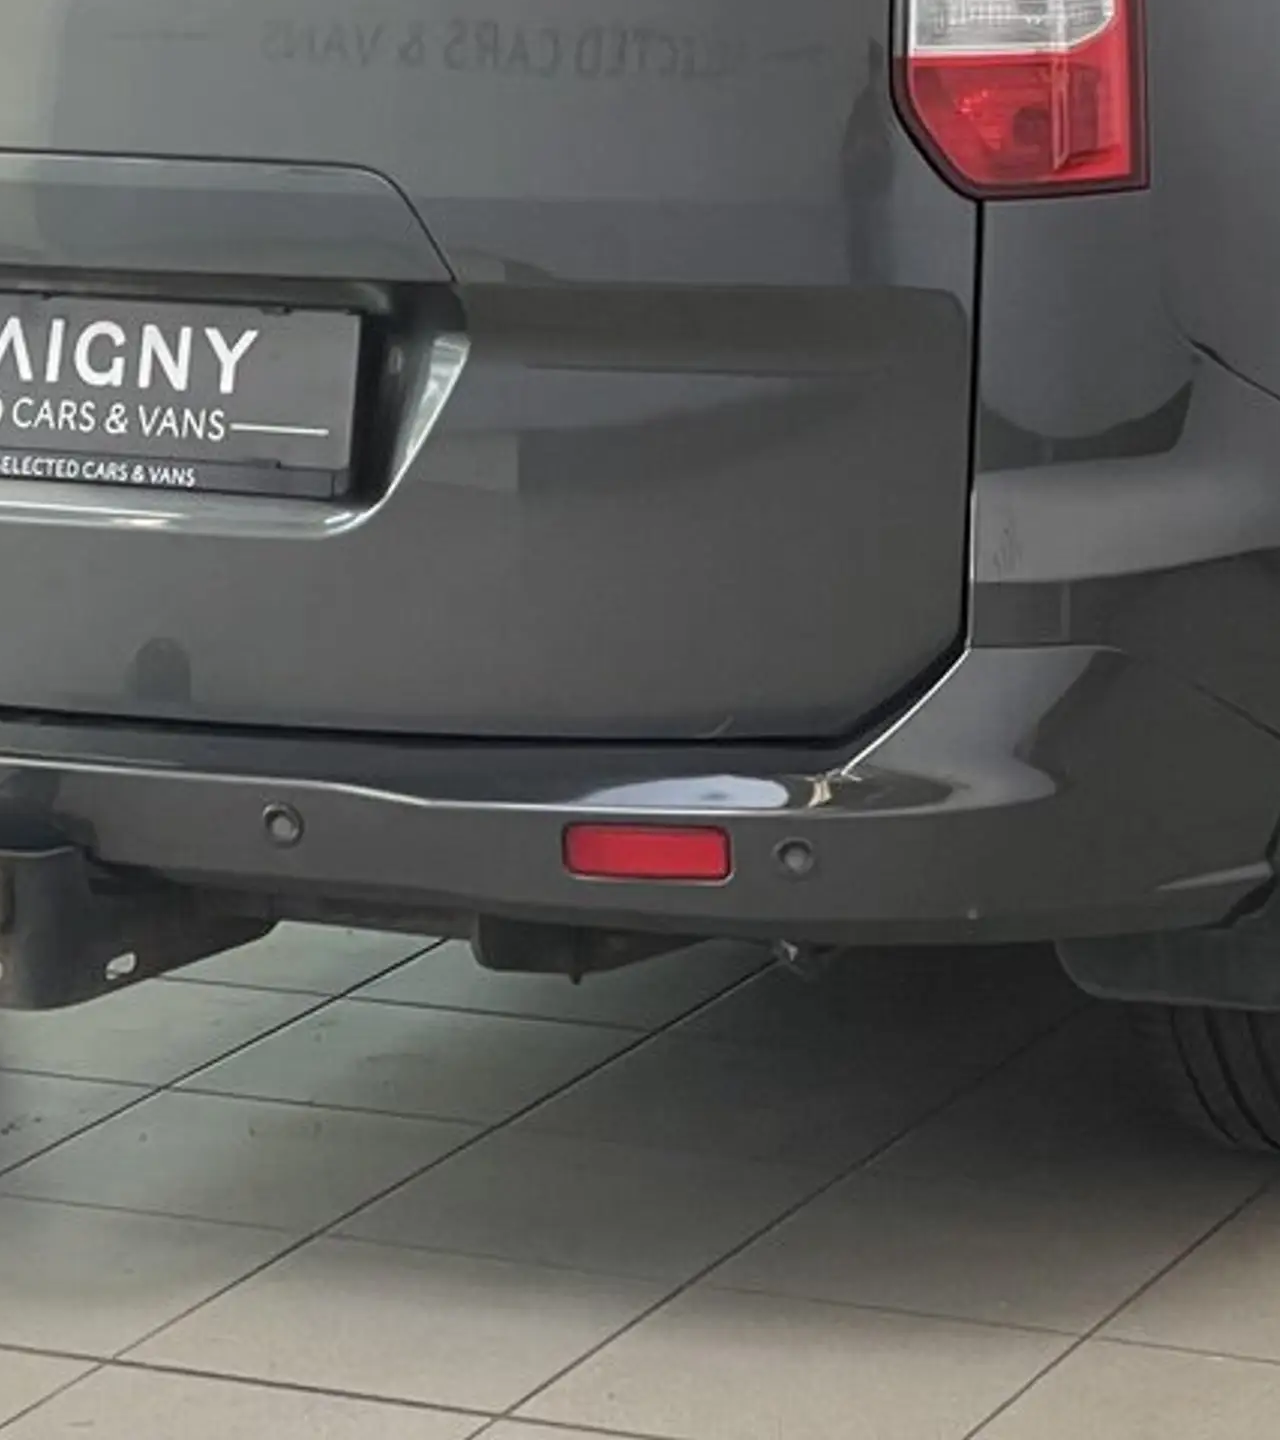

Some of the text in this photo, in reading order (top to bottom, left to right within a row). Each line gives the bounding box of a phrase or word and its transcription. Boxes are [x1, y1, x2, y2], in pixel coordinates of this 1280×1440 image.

[12, 396, 97, 434] CARS
[103, 401, 129, 435] &
[137, 404, 226, 442] VANS
[81, 459, 130, 482] CARS
[131, 463, 145, 483] &
[147, 464, 197, 488] VANS
